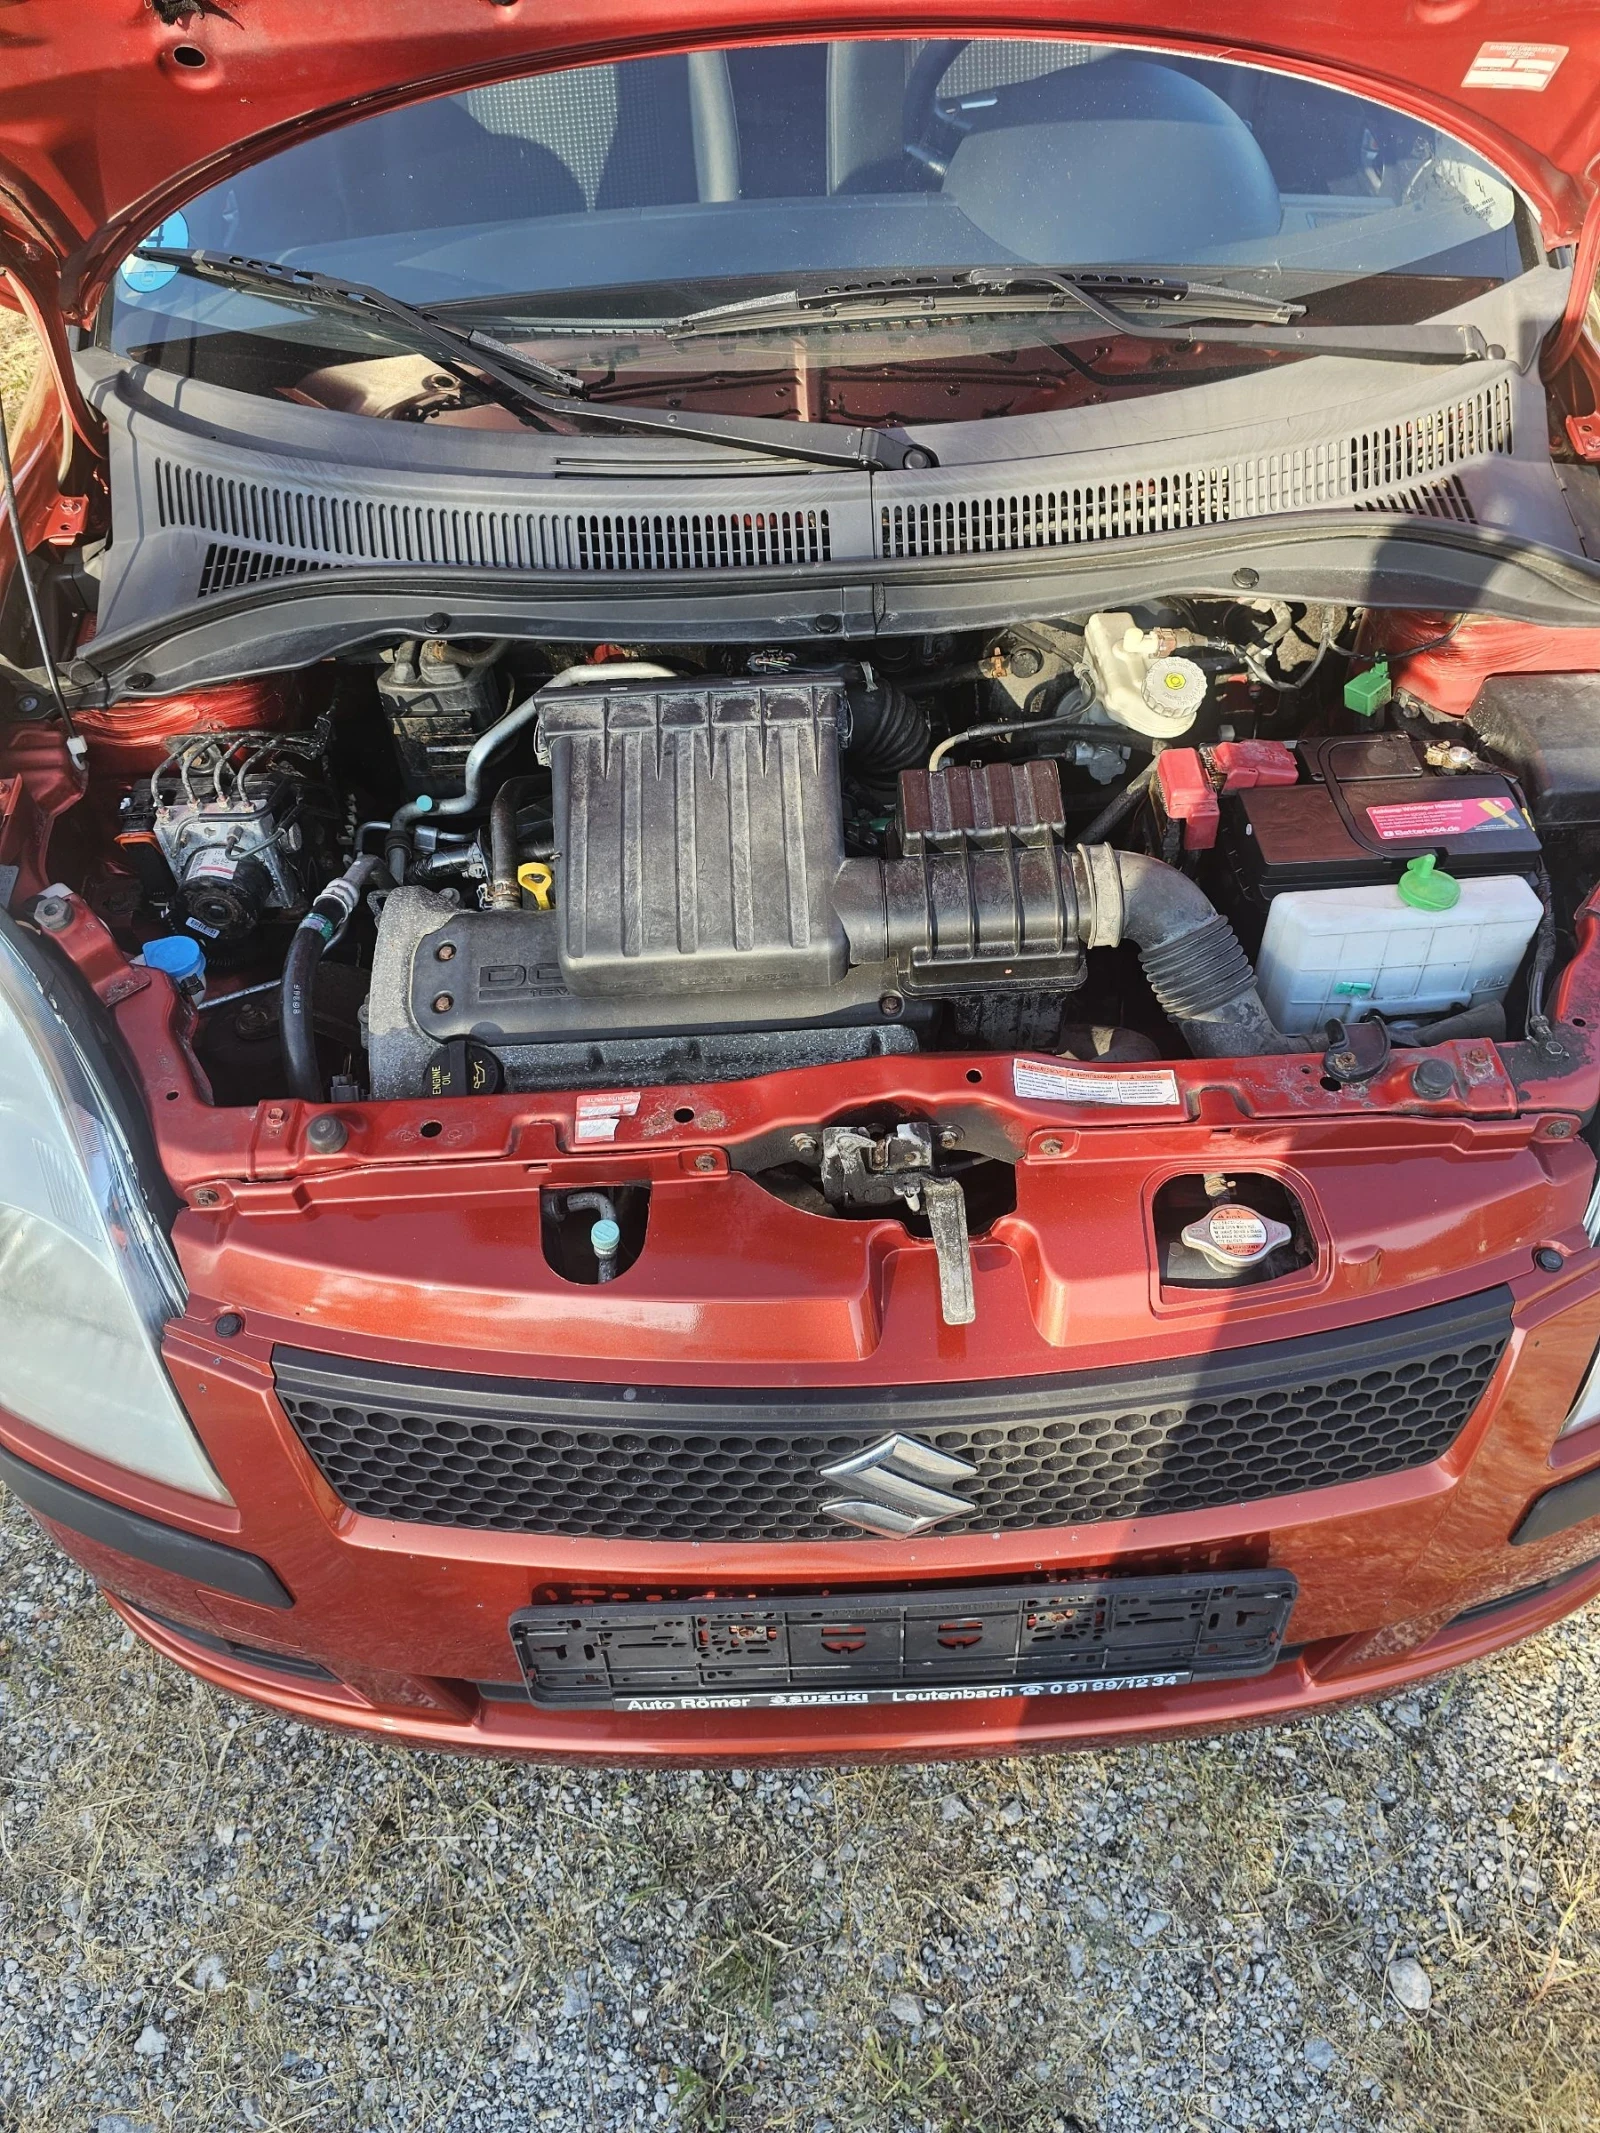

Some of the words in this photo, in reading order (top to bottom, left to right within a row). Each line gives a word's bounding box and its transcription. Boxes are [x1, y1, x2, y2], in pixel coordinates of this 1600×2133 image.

[1473, 974, 1506, 989] FULL
[431, 1065, 442, 1095] ENGINE
[442, 1072, 452, 1085] OIL
[627, 1699, 676, 1711] Auto
[681, 1697, 750, 1709] Römer
[789, 1693, 869, 1703] SUZUKI
[892, 1687, 1013, 1702] Leutenbach
